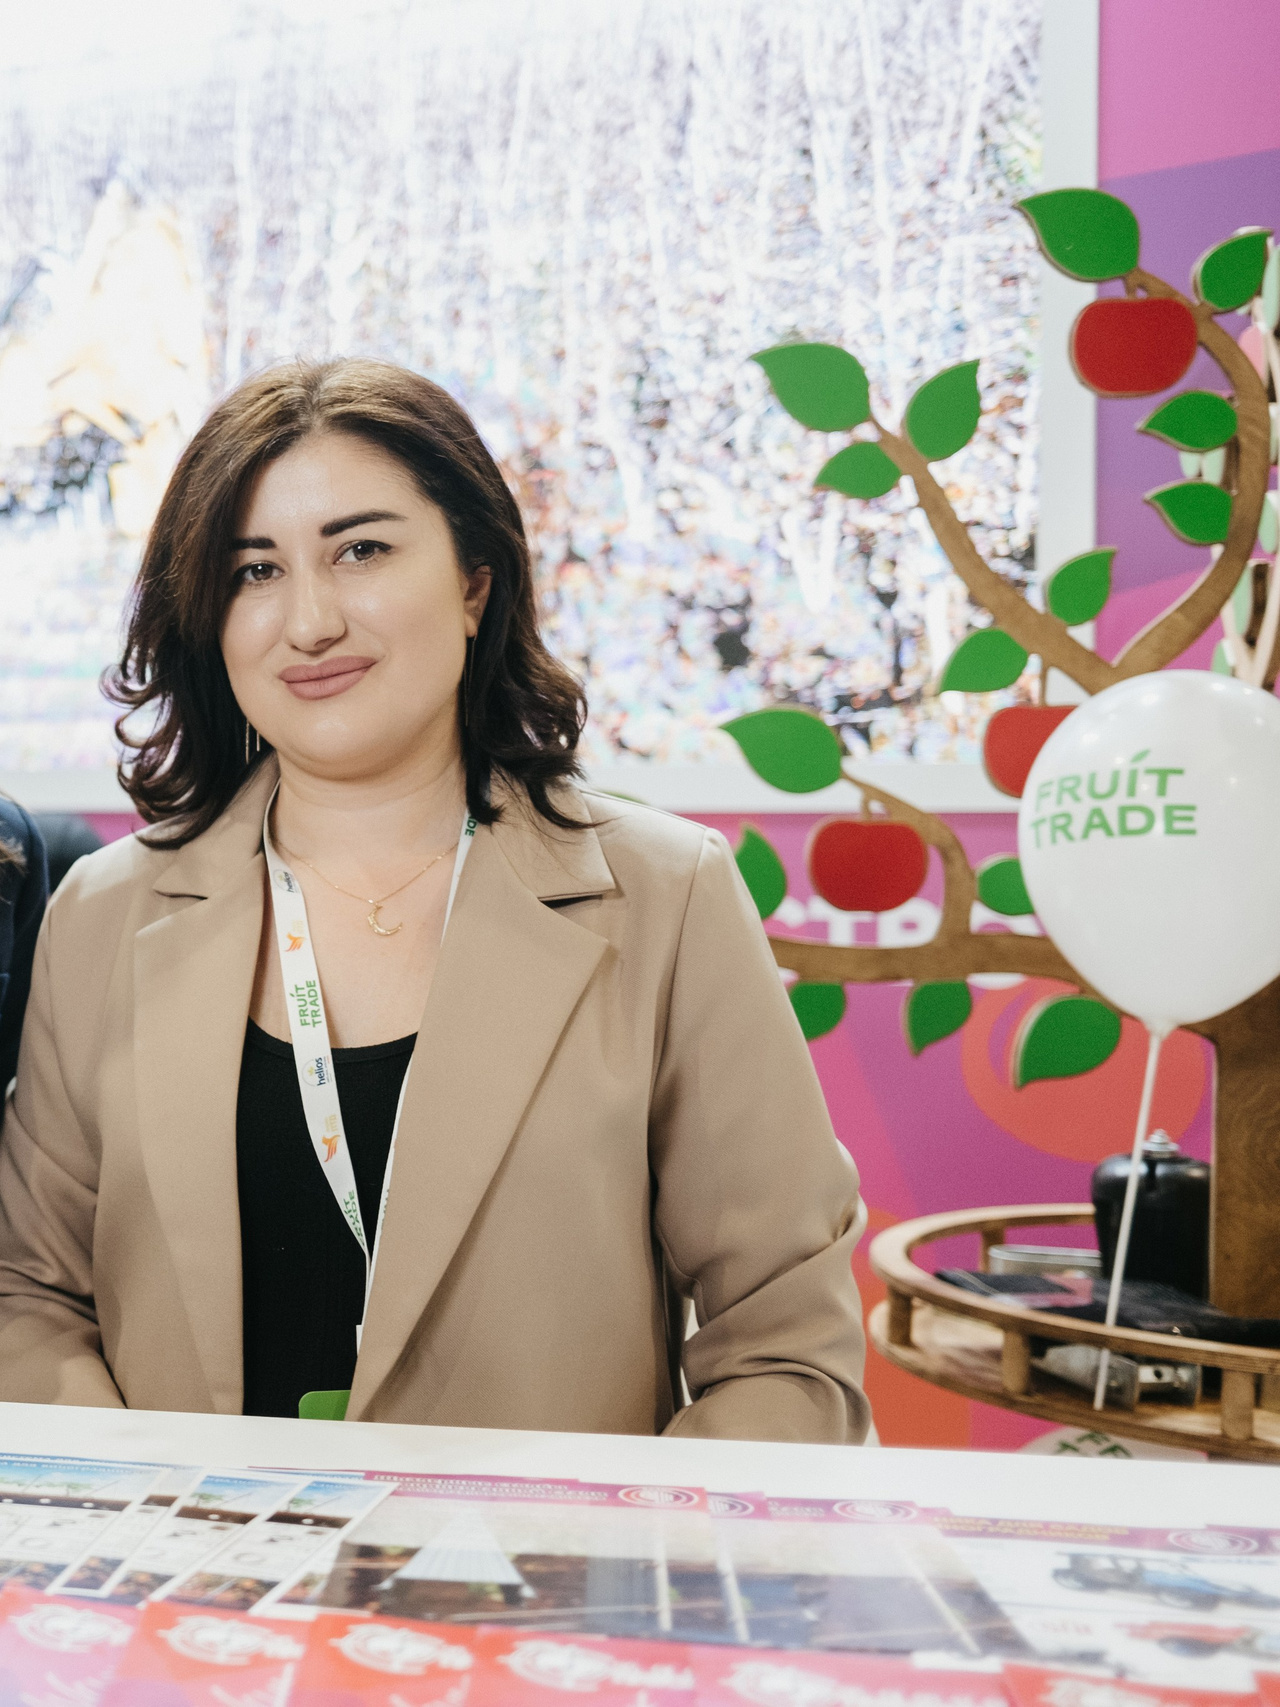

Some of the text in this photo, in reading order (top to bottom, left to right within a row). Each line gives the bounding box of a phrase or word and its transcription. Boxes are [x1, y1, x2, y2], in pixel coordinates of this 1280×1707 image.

[1030, 804, 1197, 849] TRADE
[306, 980, 323, 1028] TRADE
[317, 1057, 327, 1086] helios
